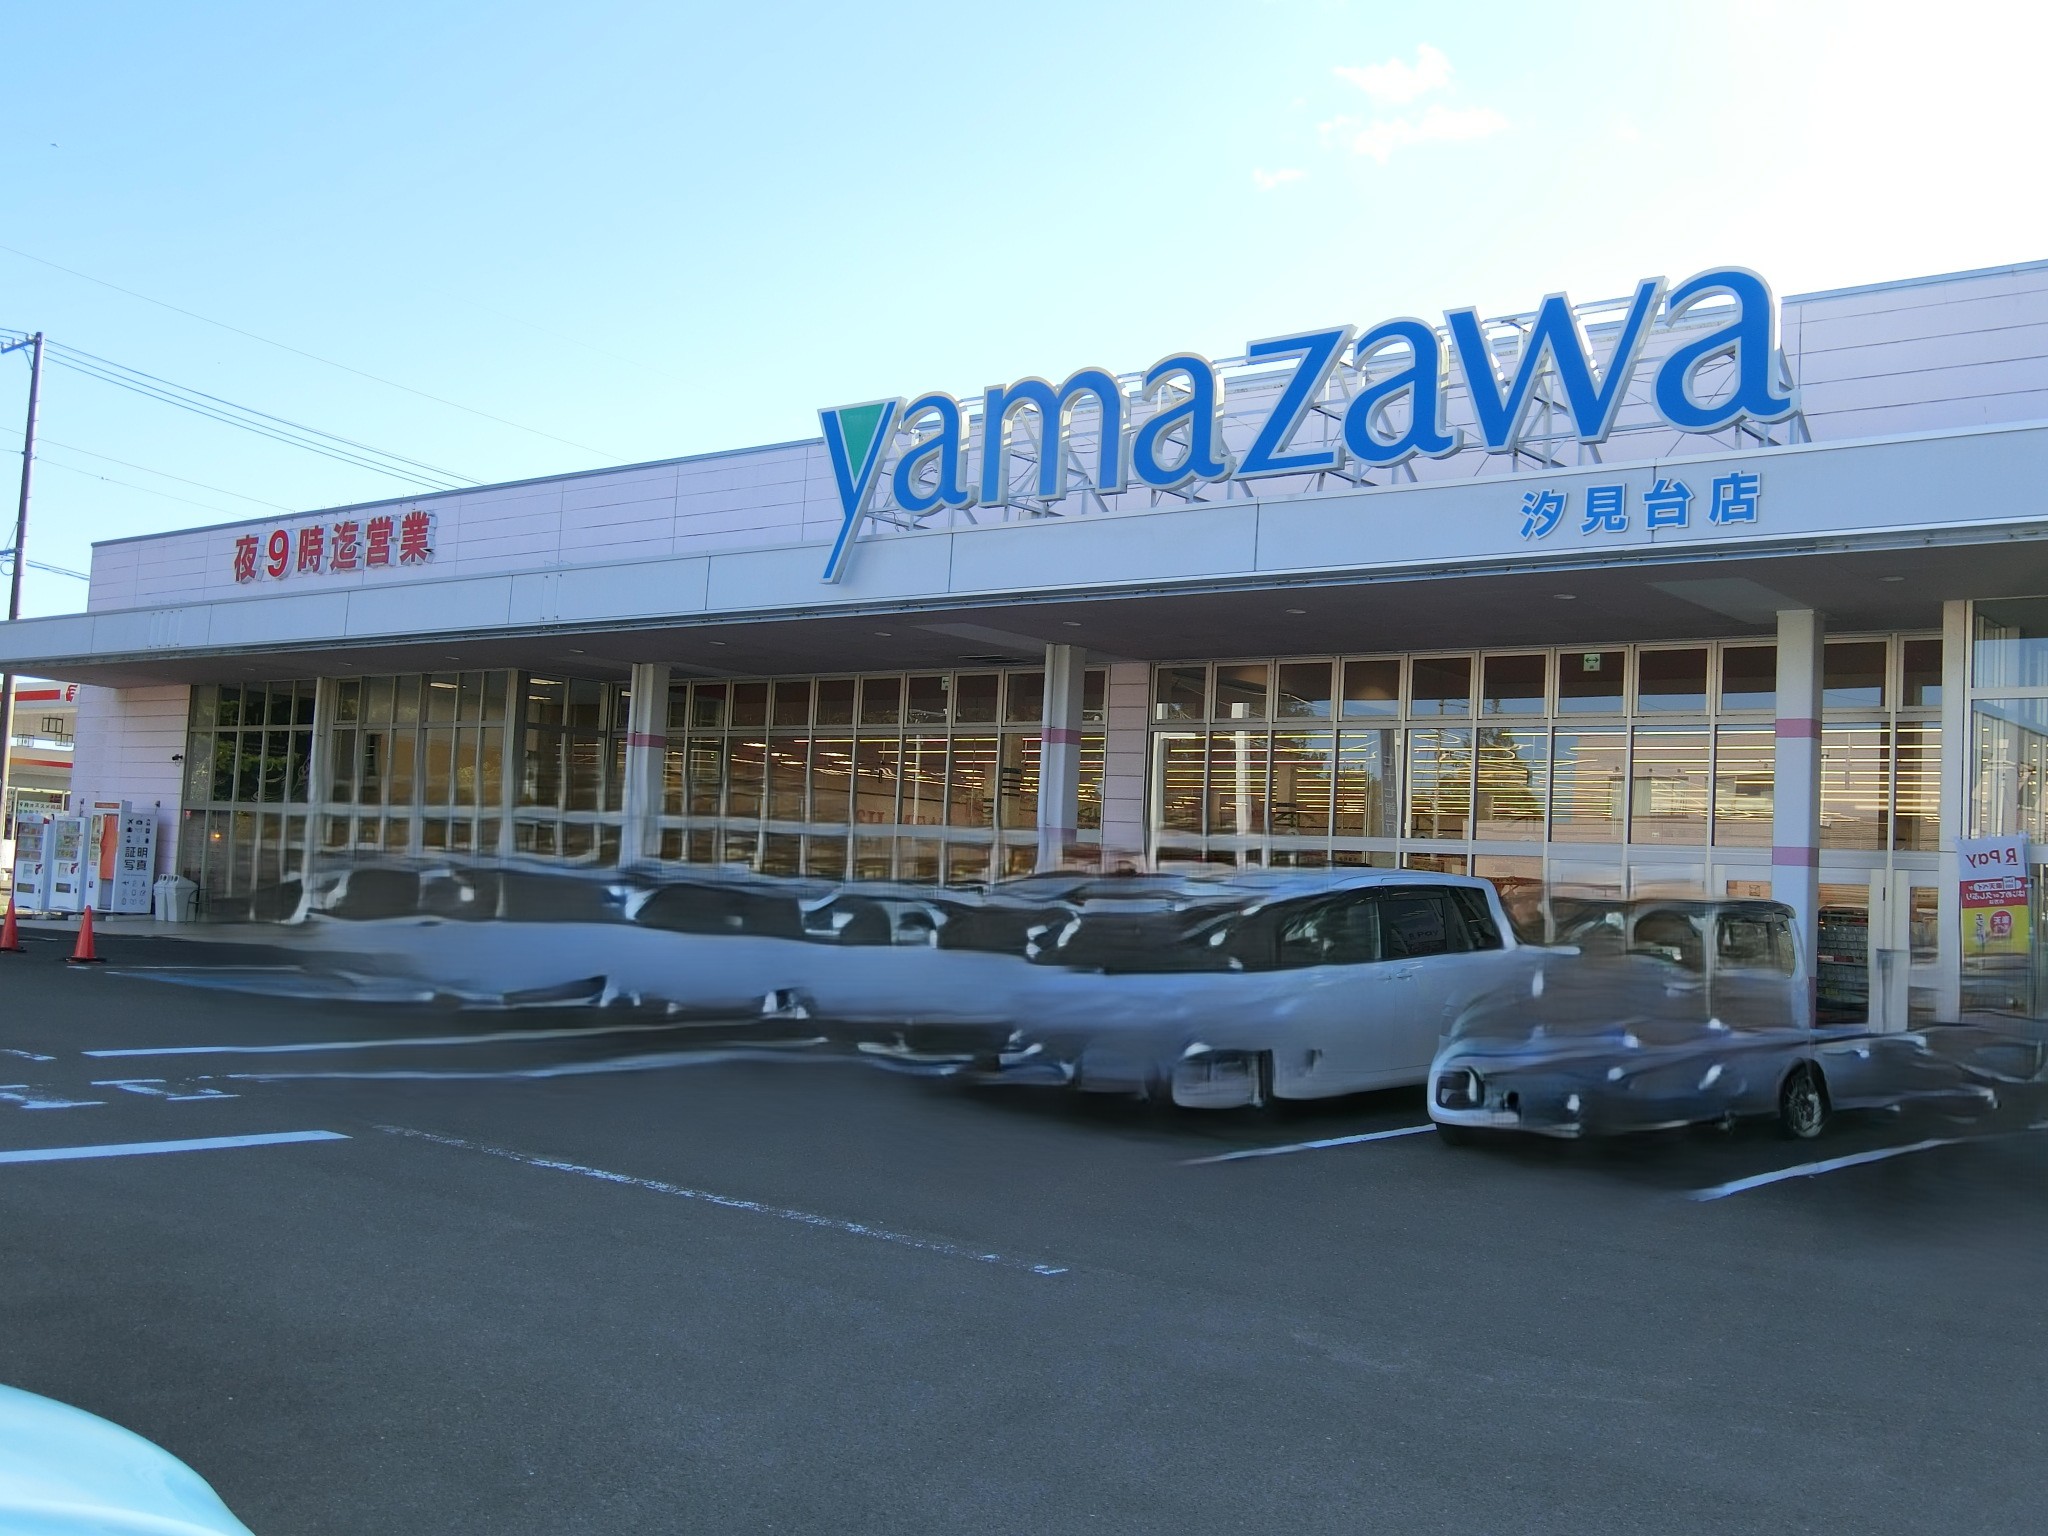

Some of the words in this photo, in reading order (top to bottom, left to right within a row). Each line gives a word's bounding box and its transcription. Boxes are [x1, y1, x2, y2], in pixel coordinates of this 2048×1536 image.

[818, 265, 1794, 583] yamazawa
[1518, 470, 1762, 541] 汐見台店
[233, 510, 431, 584] 夜9時迄営業
[124, 846, 148, 858] 証明
[124, 859, 148, 871] 写真
